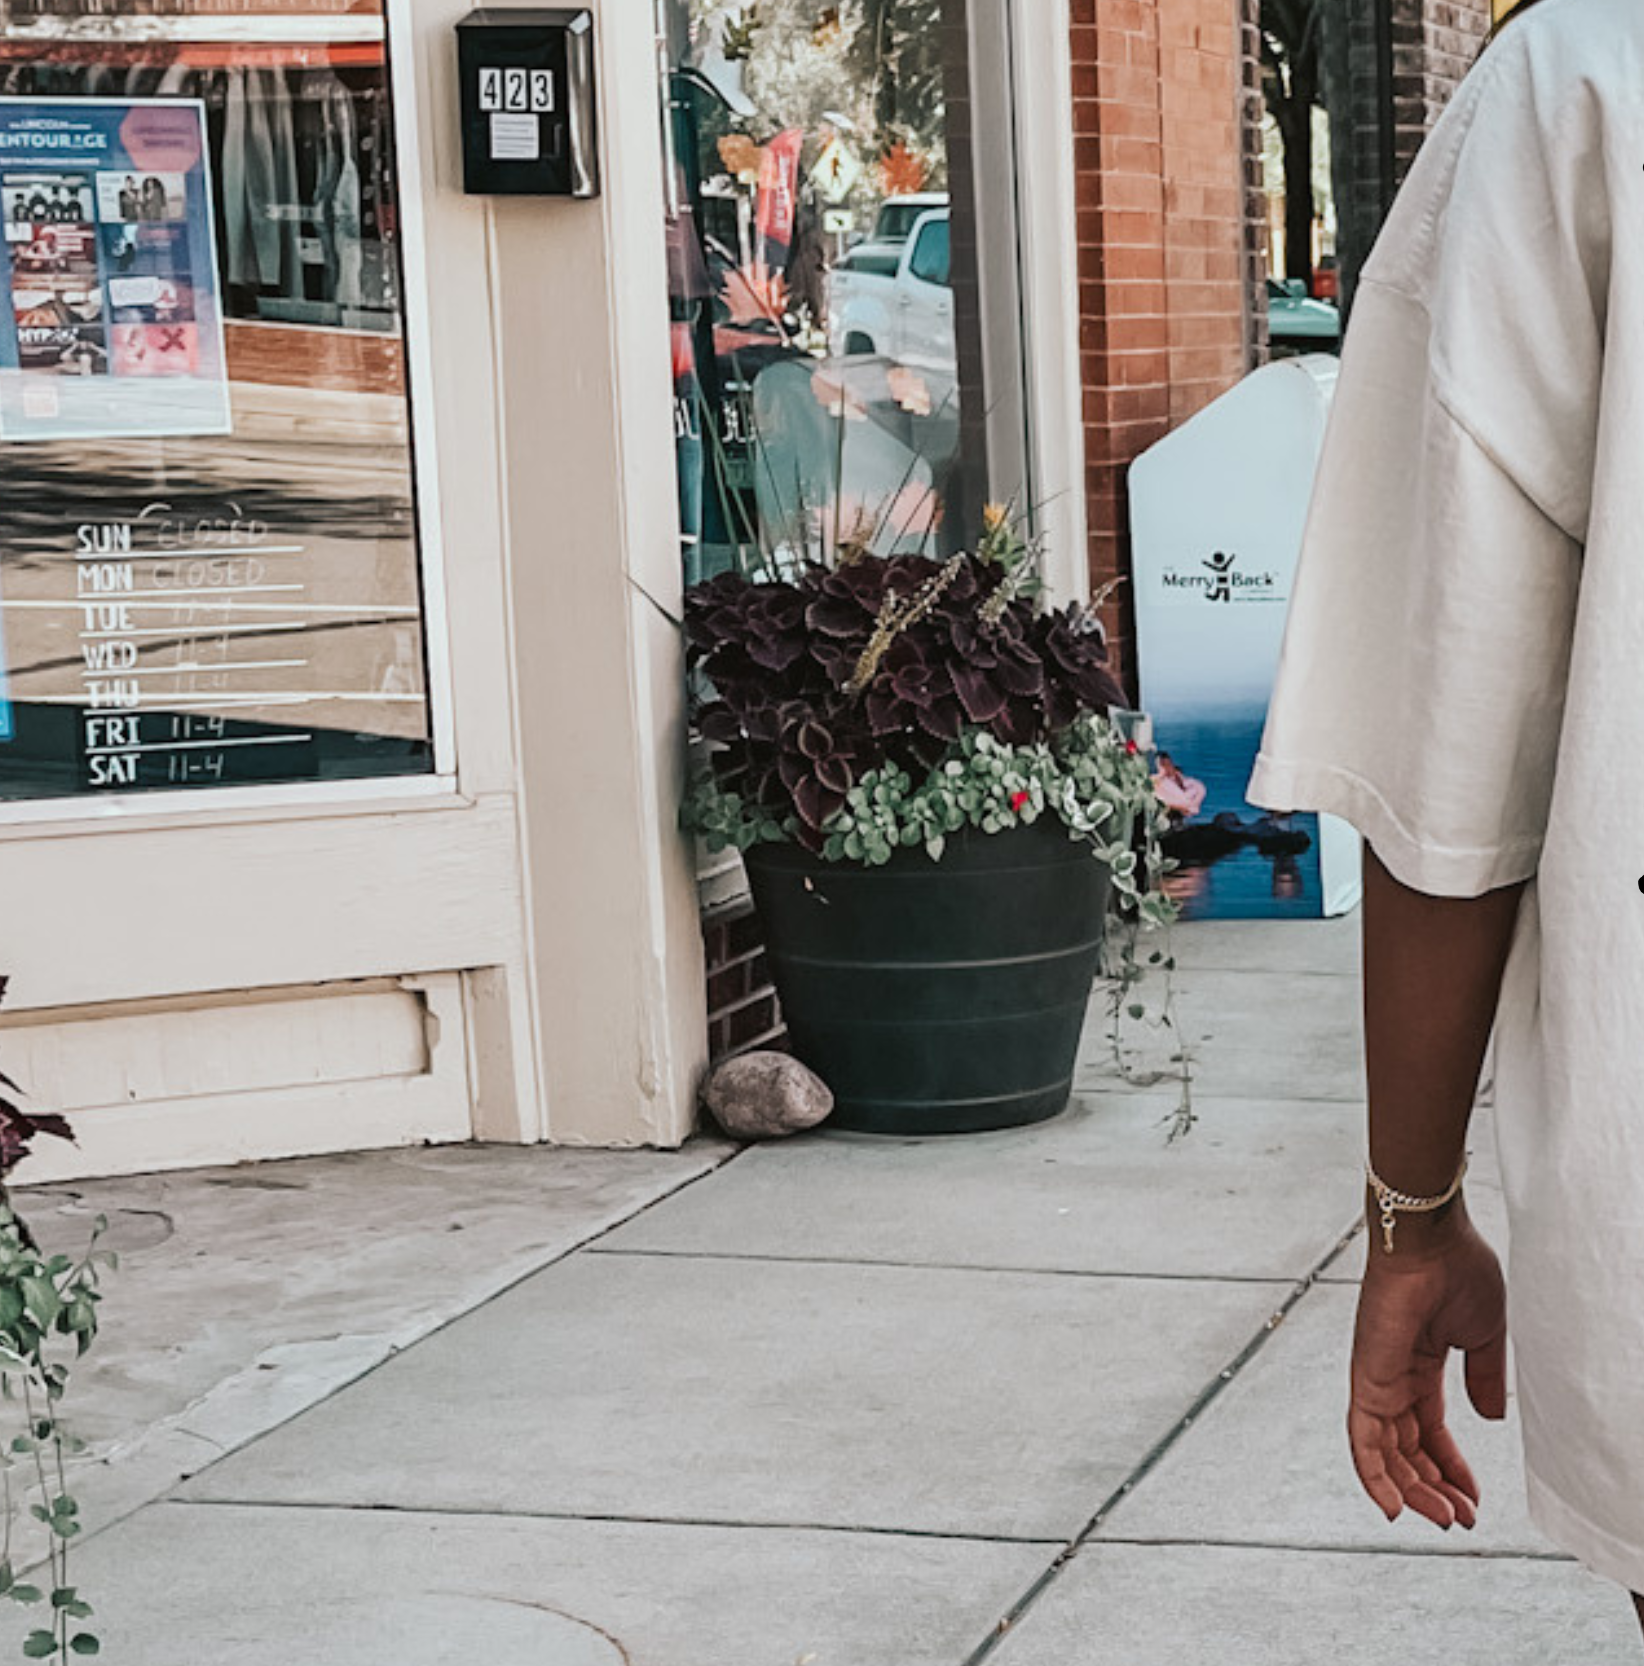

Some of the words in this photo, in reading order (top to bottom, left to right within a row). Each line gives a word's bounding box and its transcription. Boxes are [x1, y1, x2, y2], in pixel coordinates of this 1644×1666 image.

[484, 71, 549, 107] 423
[76, 524, 131, 552] SUN
[157, 519, 268, 547] CLOSED
[77, 563, 133, 592] MON
[153, 558, 265, 588] CLOSED
[1162, 574, 1214, 590] Merry
[1231, 572, 1273, 586] Back
[84, 605, 134, 630] TUE
[82, 641, 137, 669] WED
[83, 679, 139, 708] THU
[85, 716, 140, 746] FRI
[172, 715, 224, 737] 11-4
[88, 753, 141, 785] SAT
[168, 753, 224, 781] 11-4
